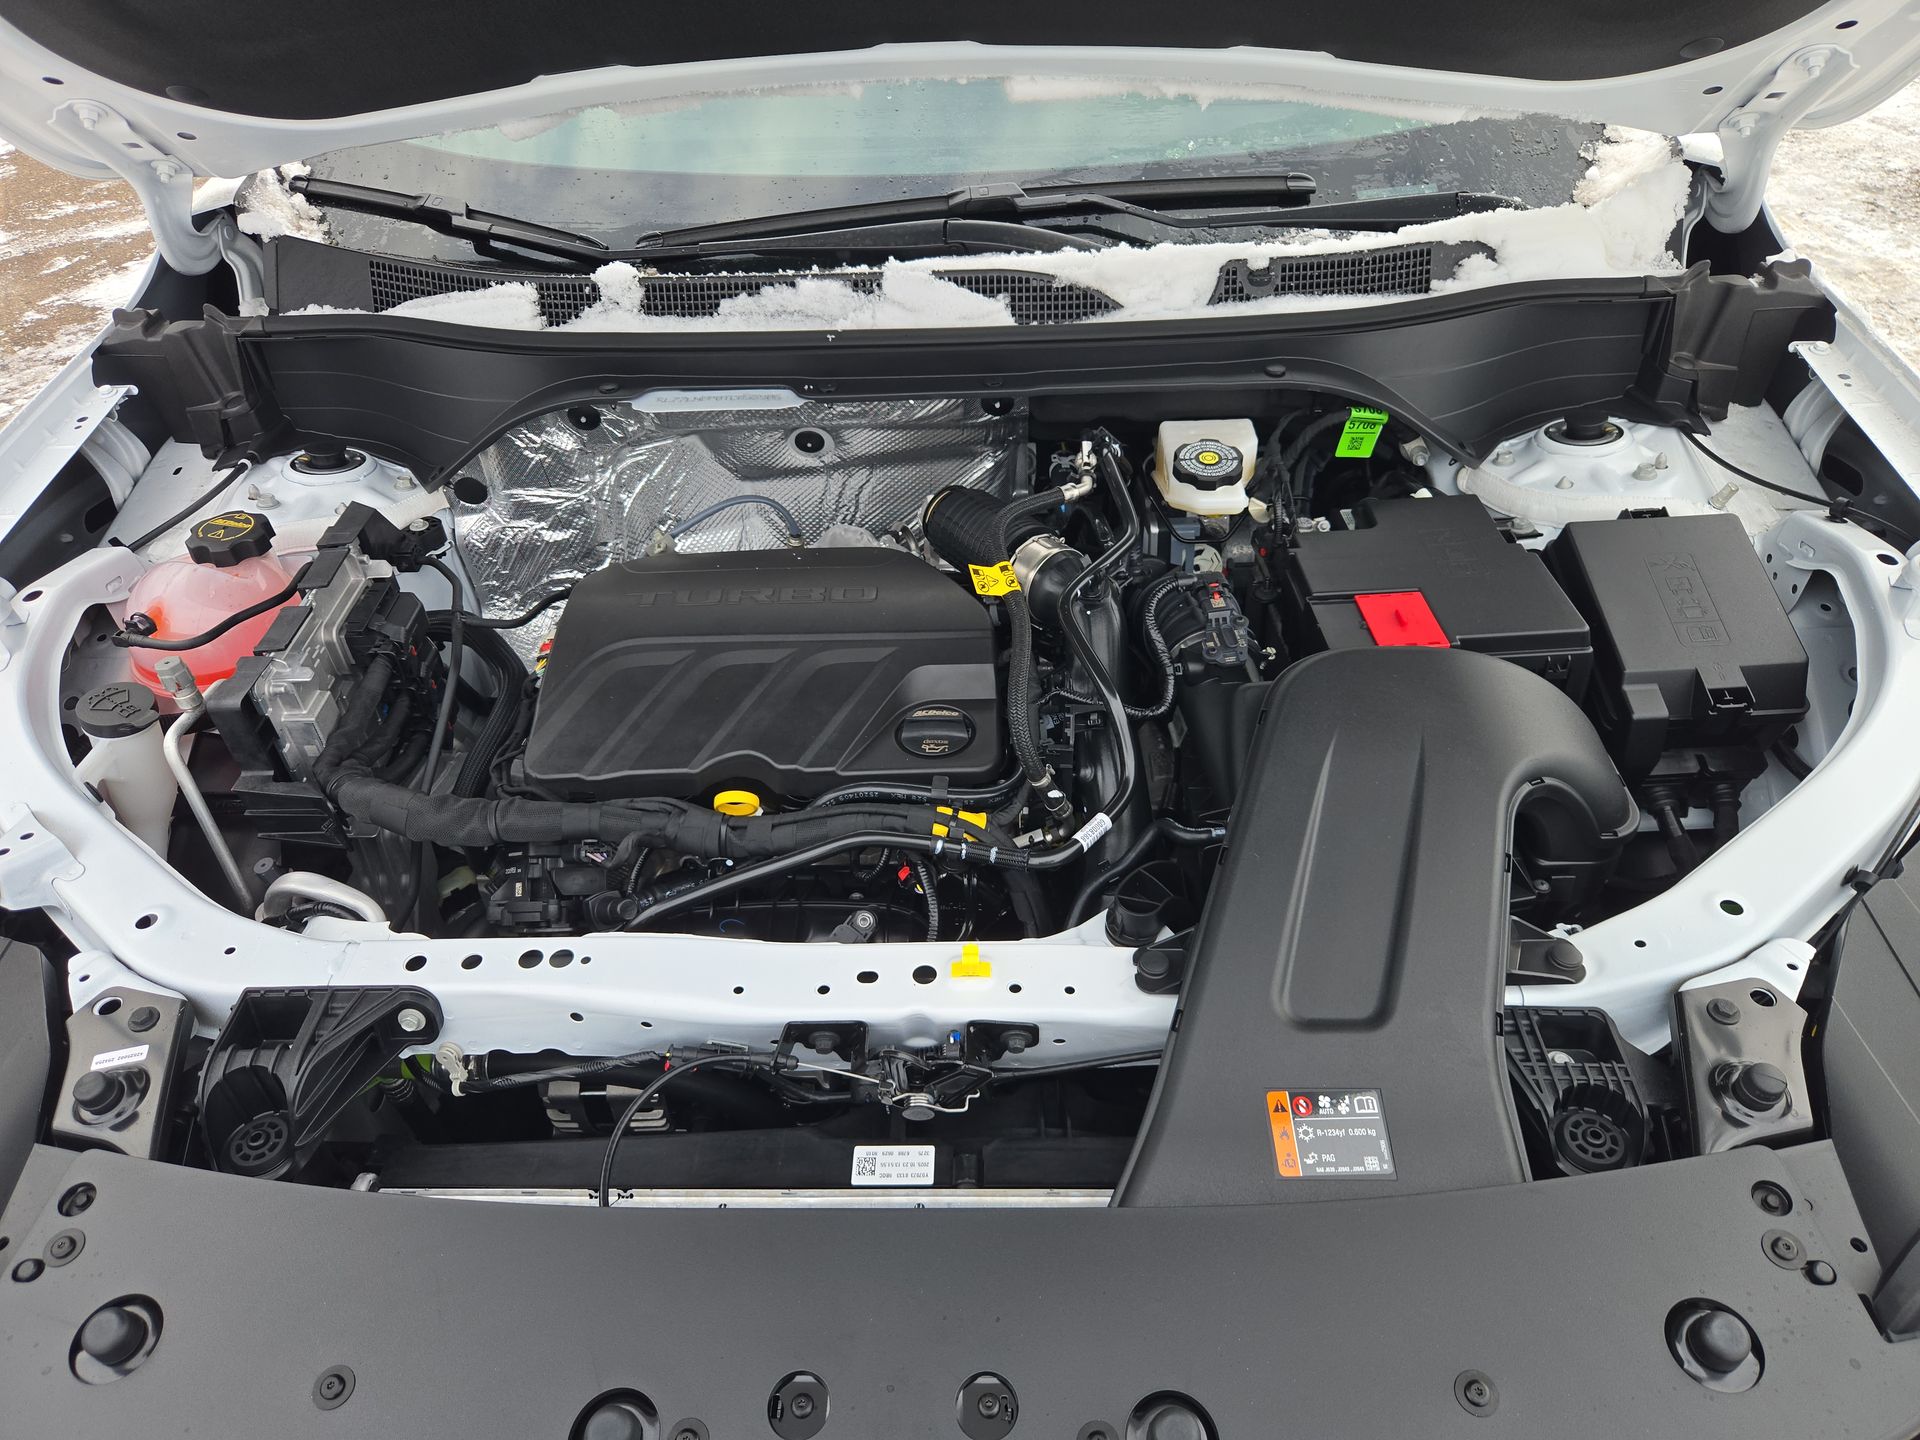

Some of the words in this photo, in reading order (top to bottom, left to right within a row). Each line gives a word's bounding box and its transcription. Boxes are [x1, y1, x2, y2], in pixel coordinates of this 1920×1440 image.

[624, 584, 879, 608] TURBO
[912, 709, 960, 717] ACDelco
[1348, 1128, 1367, 1137] 0.600
[1367, 1128, 1376, 1137] kg
[1321, 1154, 1336, 1162] PAG
